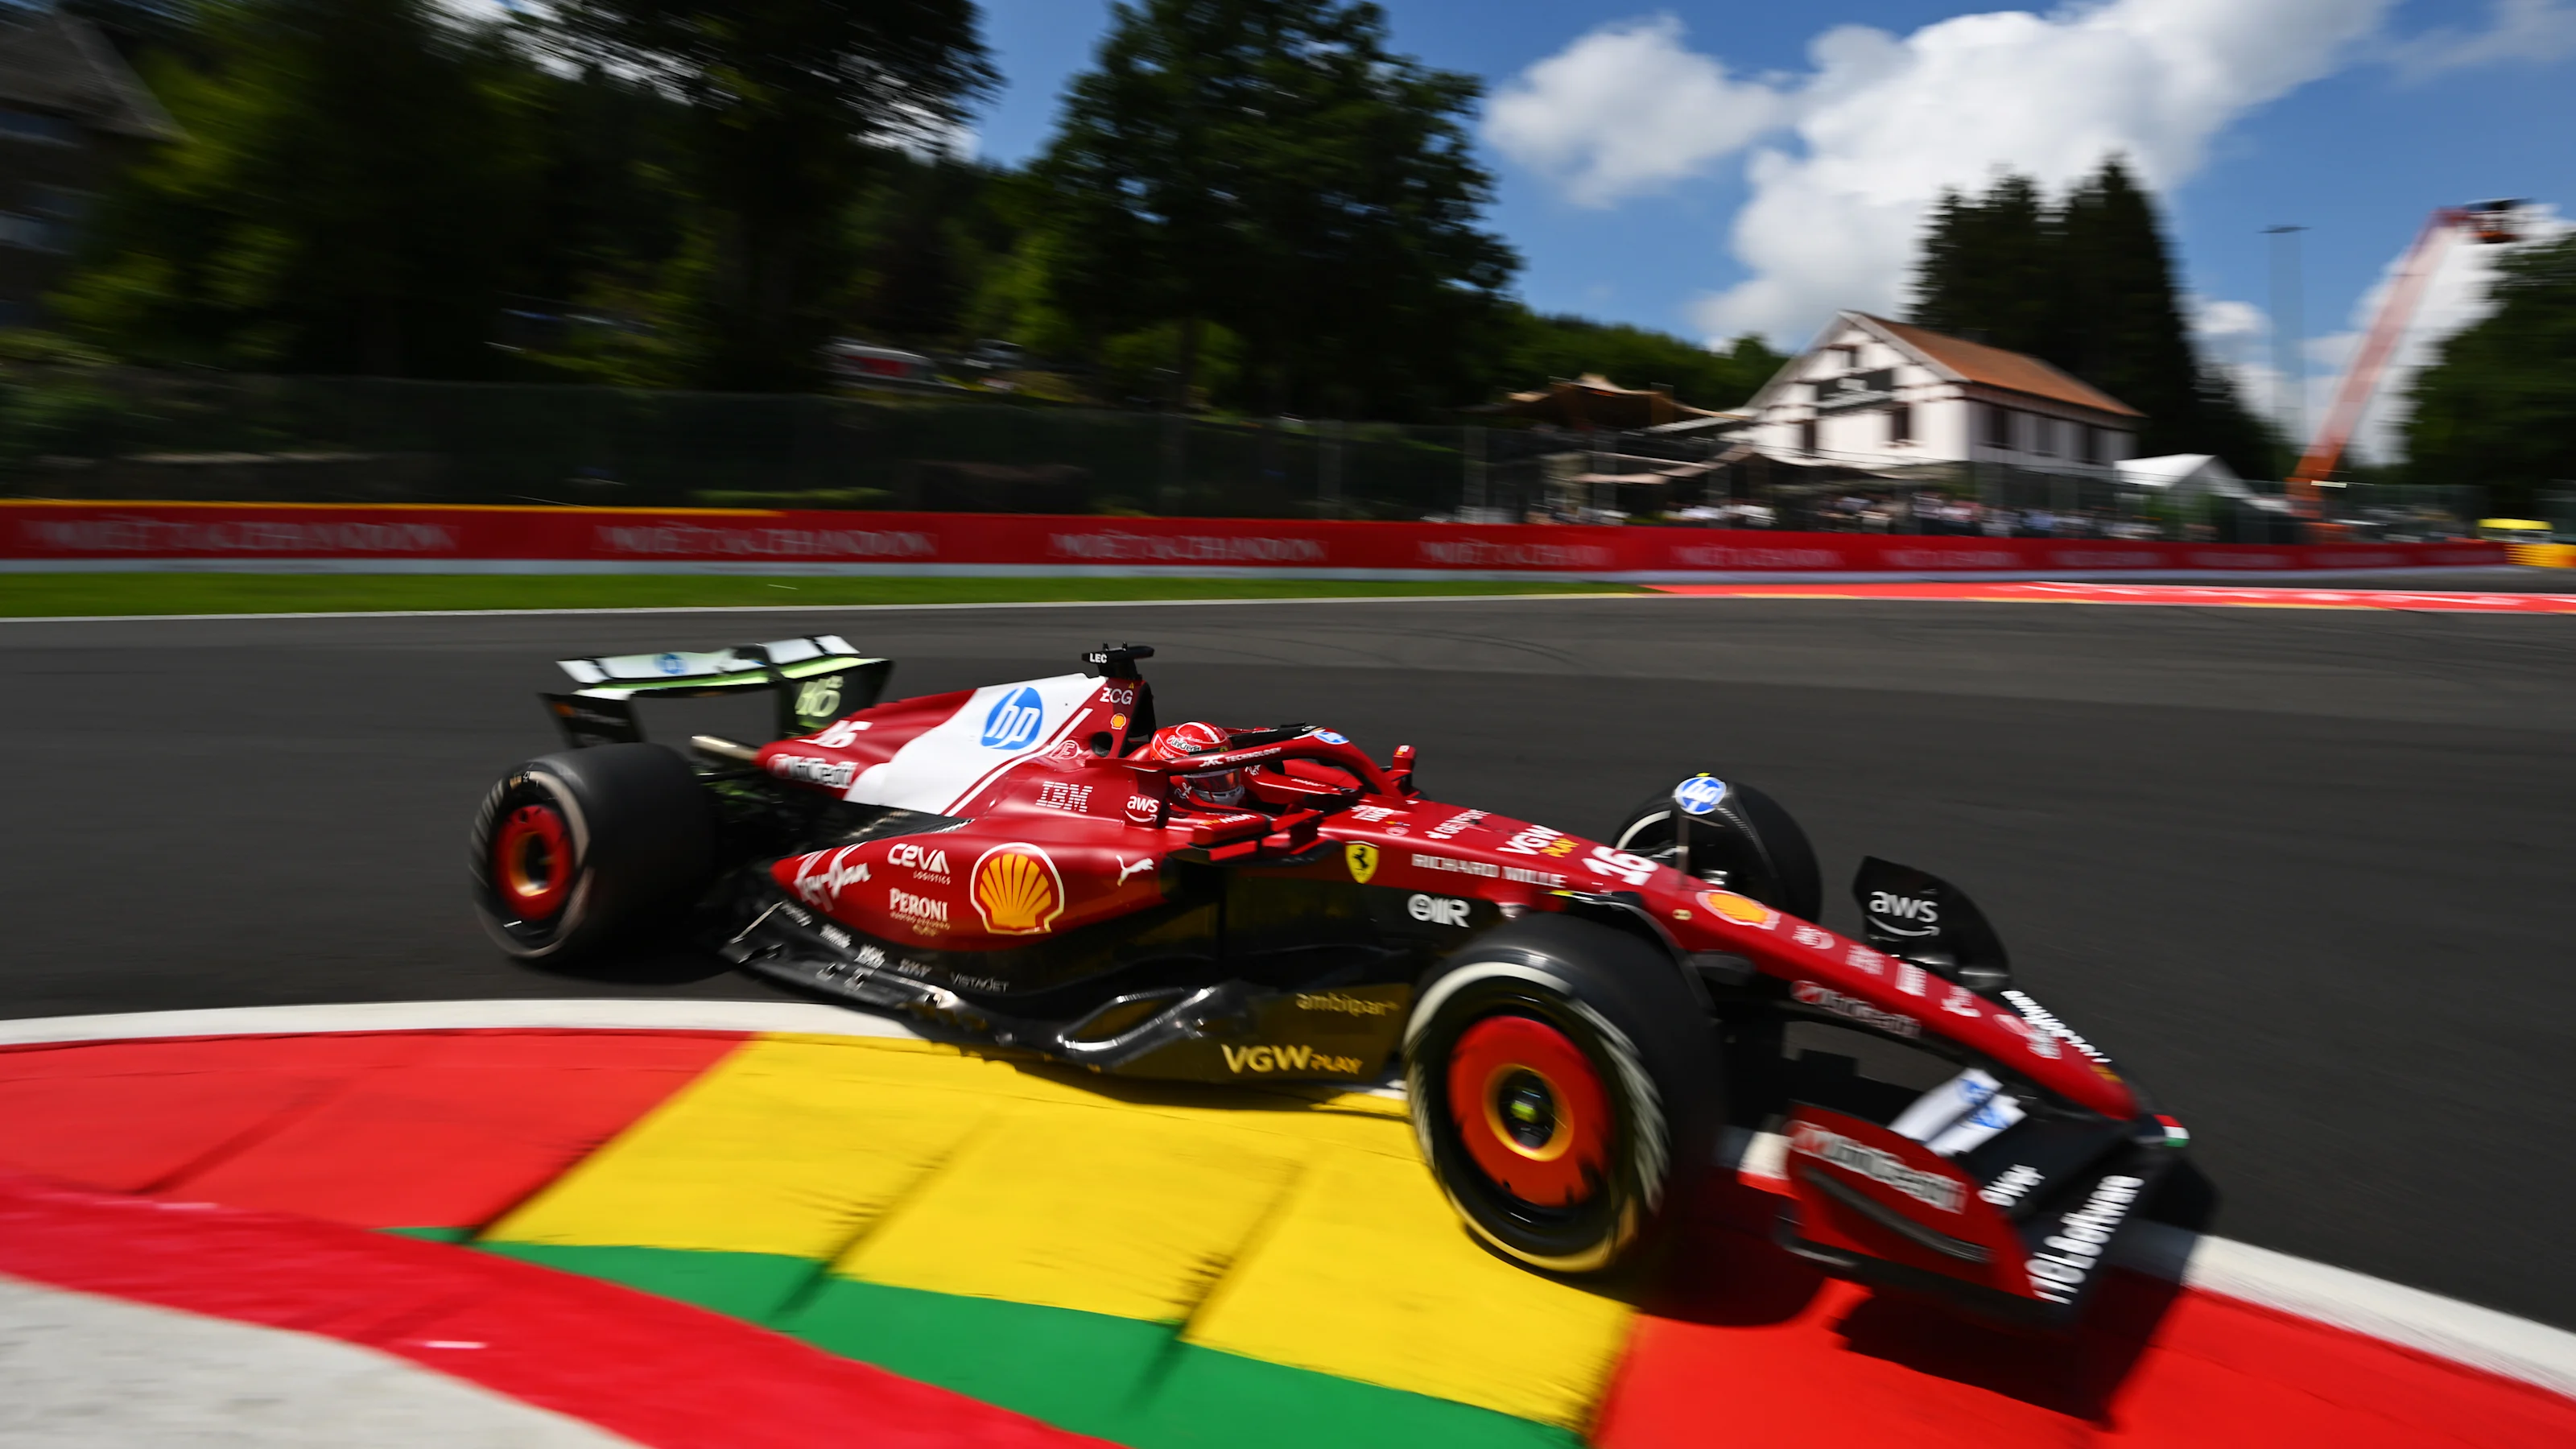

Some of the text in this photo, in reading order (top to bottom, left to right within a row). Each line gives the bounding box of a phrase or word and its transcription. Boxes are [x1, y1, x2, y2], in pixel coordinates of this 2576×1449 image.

[1089, 653, 1108, 663] LEC
[795, 675, 844, 717] 16
[1100, 687, 1133, 704] ZCG
[981, 687, 1042, 750] hp
[795, 720, 873, 749] 16
[1171, 737, 1202, 753] UniCredit
[1225, 747, 1282, 762] TECHNOLOGY
[1035, 781, 1093, 812] IBM
[1127, 795, 1160, 813] aws
[1496, 824, 1564, 855] VGW
[913, 870, 952, 885] LOGISTICS
[1411, 853, 1501, 878] RICHARD
[1581, 846, 1659, 886] 16
[890, 888, 948, 922] PERONI
[1869, 891, 1938, 923] aws
[1221, 1044, 1312, 1074] VGW
